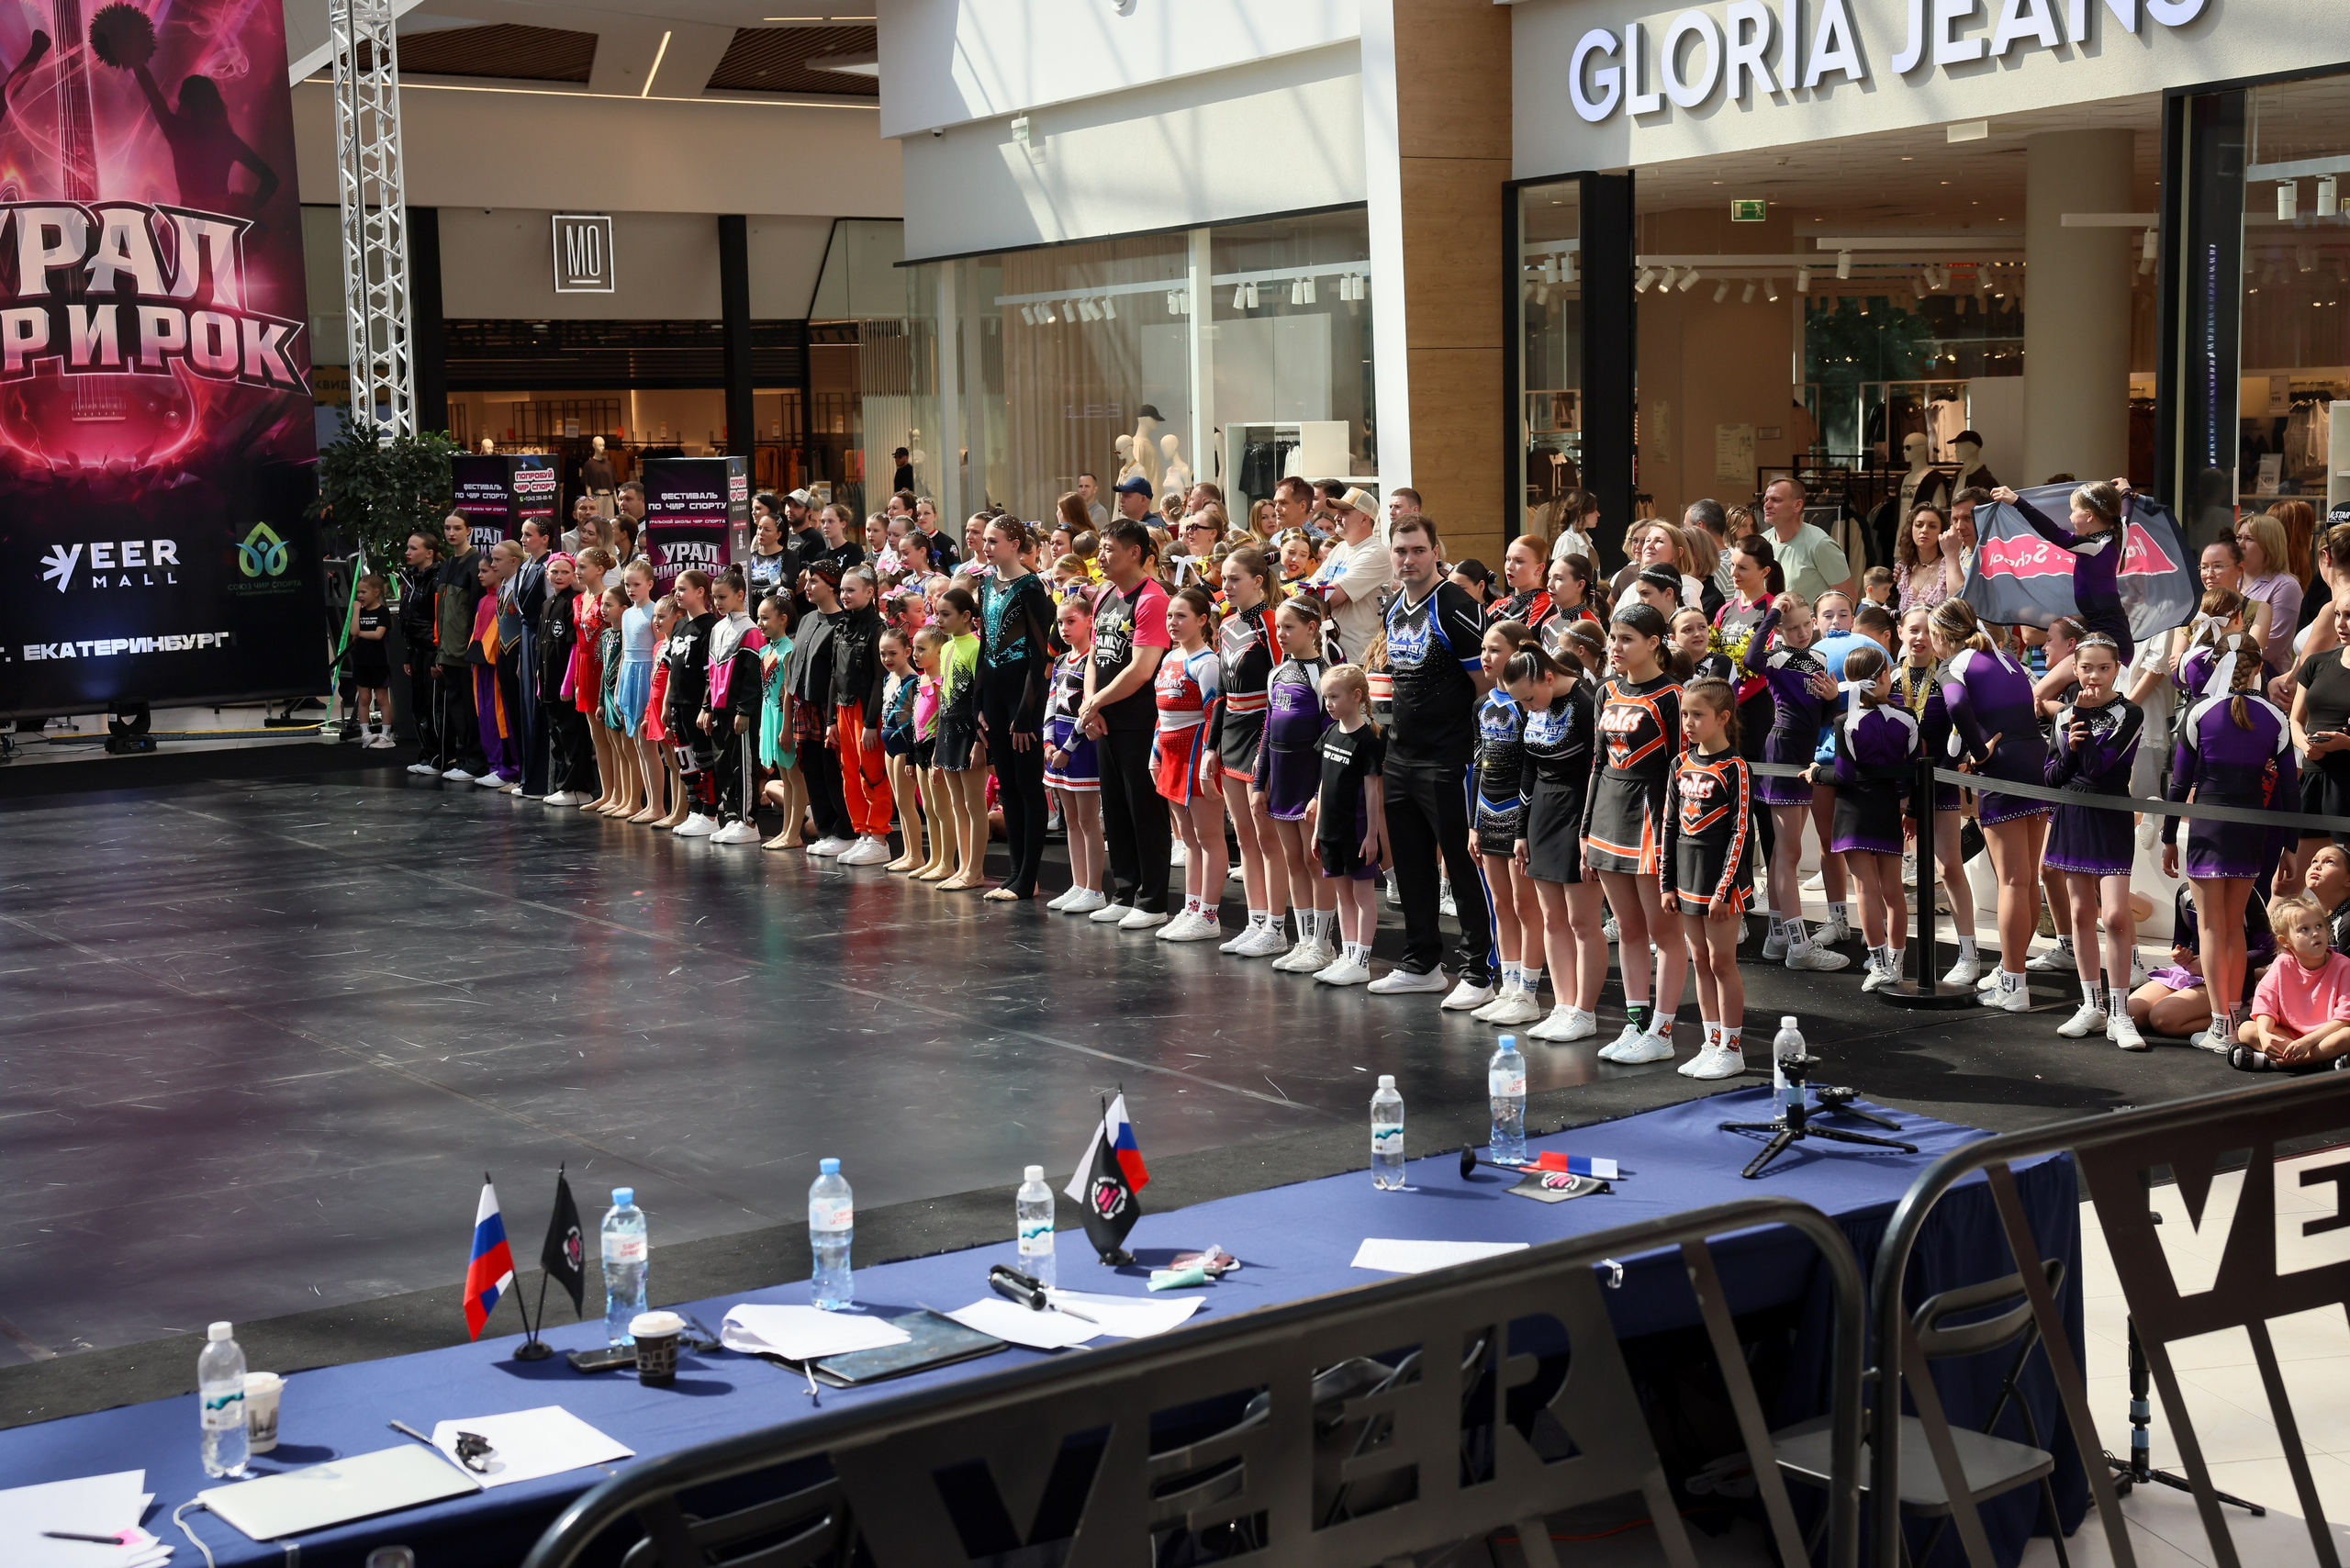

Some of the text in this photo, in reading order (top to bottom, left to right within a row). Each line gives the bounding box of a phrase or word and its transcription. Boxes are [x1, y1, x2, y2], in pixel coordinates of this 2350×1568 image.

[1568, 0, 1867, 123] GLORIA
[0, 207, 241, 310] РАЛ
[67, 305, 120, 365] И
[136, 305, 297, 386] РОК
[516, 469, 554, 479] ПОПРОБУЙ
[515, 483, 555, 492] ЧИР СПОРТ
[661, 492, 718, 500] ФЕСТИВАЛЬ
[666, 502, 685, 510] ЧИР
[688, 501, 727, 510] СПОРТУ
[659, 543, 720, 564] УРАЛ
[93, 572, 177, 588] MALL
[653, 562, 683, 580] ЧИР
[271, 580, 302, 588] СПОРТА
[24, 632, 229, 661] ЕКАТЕРИНБУРГ
[1598, 706, 1644, 732] FOXES
[1678, 773, 1716, 798] FOXES
[933, 1312, 1582, 1568] VEER
